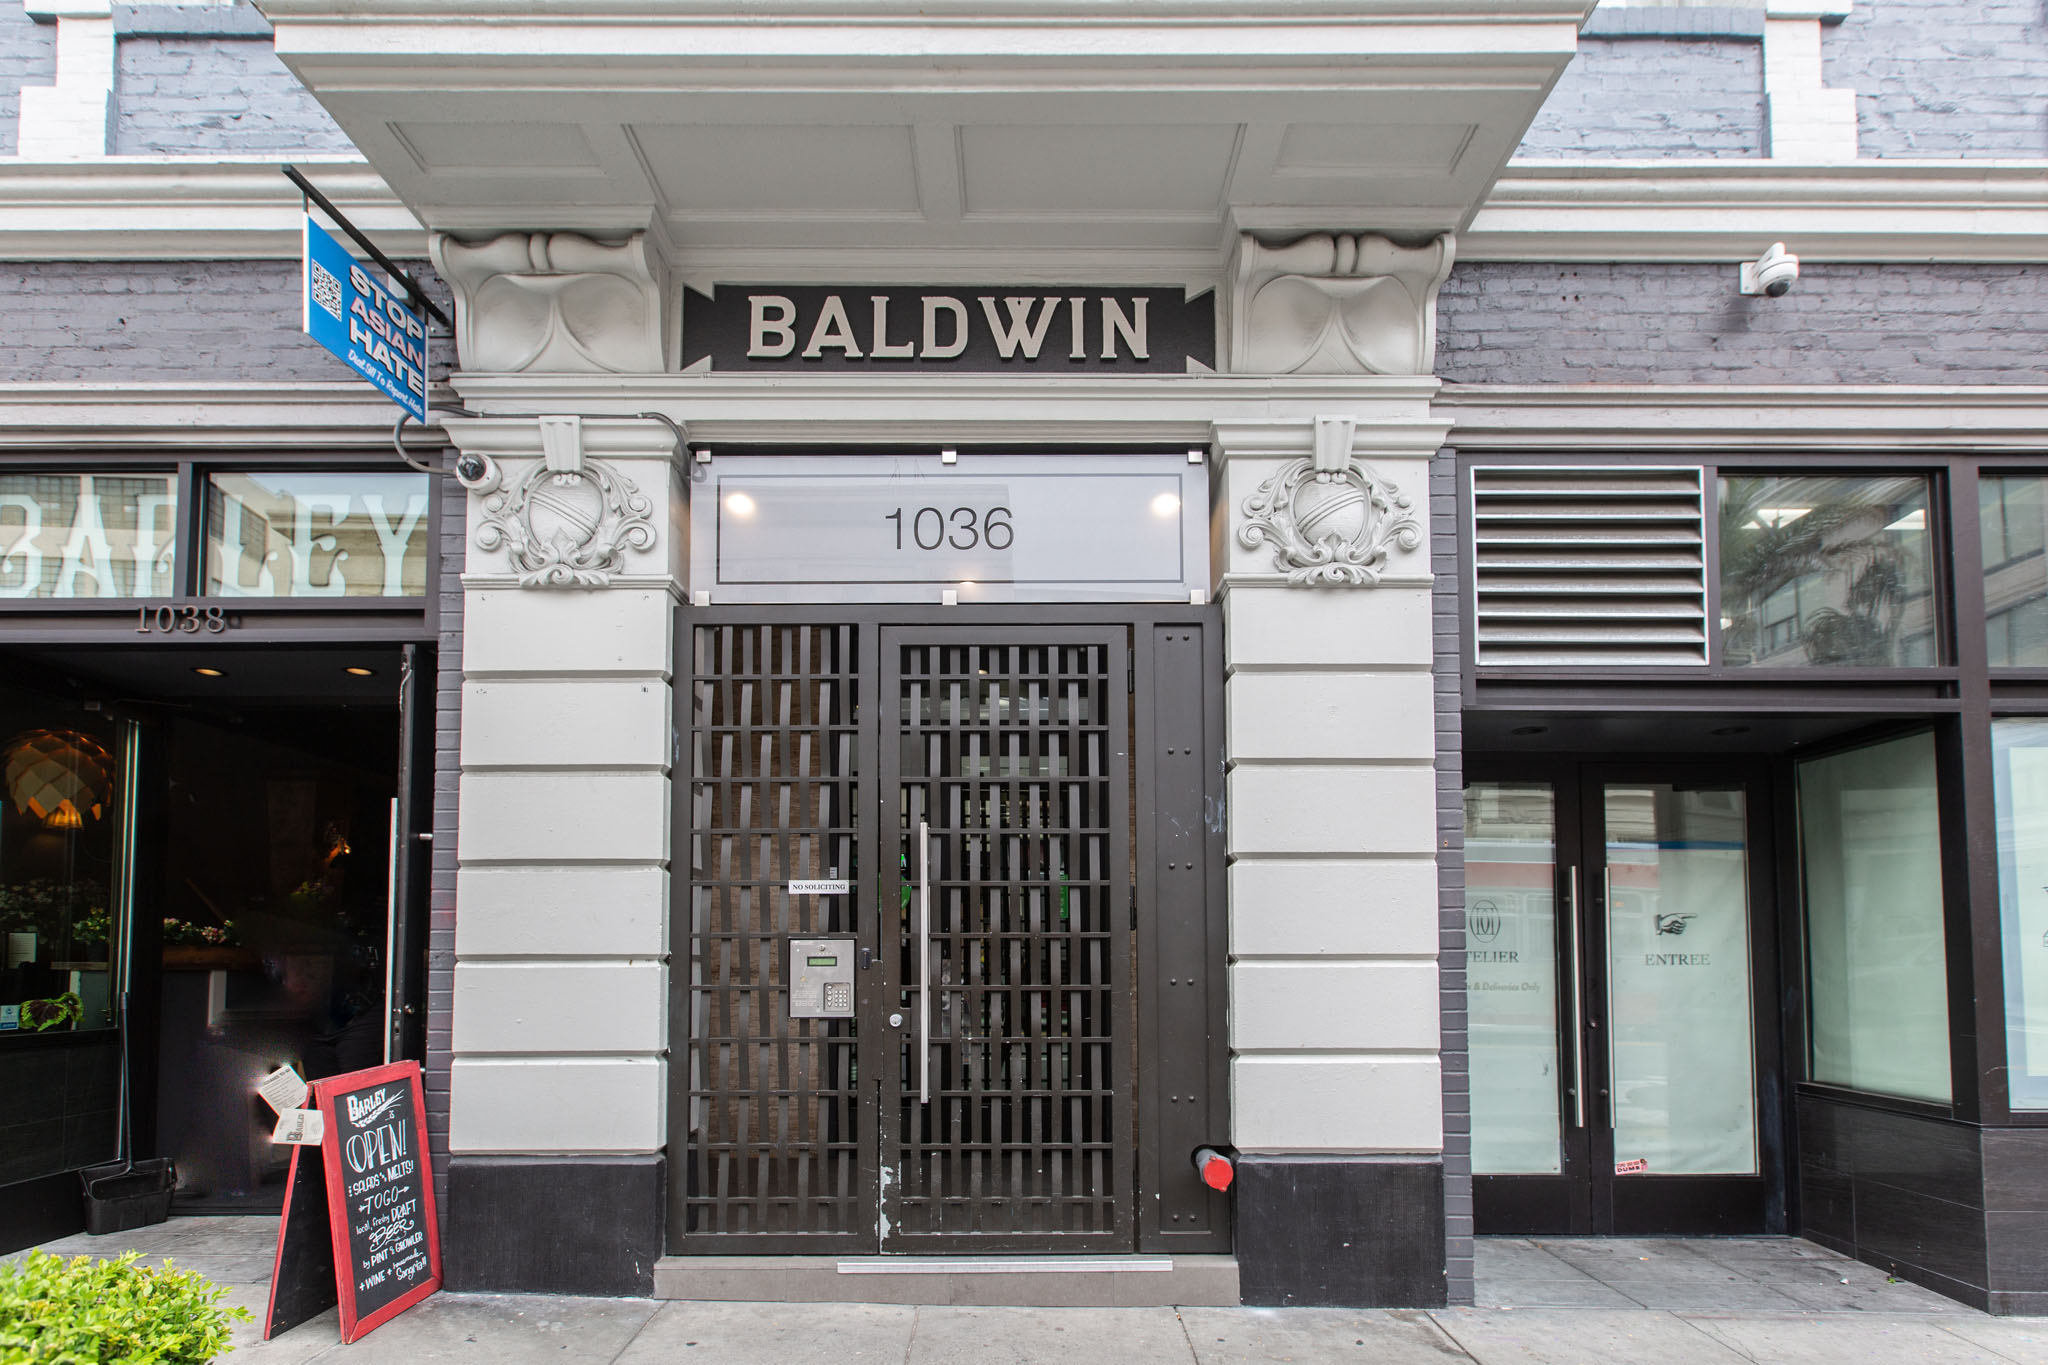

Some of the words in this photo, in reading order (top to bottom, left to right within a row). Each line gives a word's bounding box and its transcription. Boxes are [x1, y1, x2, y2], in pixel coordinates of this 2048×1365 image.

[350, 264, 423, 341] STOP
[350, 296, 423, 372] ASIAN
[747, 295, 1150, 360] BALDWIN
[348, 349, 366, 370] Dial
[376, 370, 386, 386] To
[385, 379, 409, 405] Report
[350, 317, 423, 399] HATE
[885, 507, 1015, 551] 1036
[135, 605, 226, 633] 1038
[1644, 953, 1712, 966] ENTREE
[1521, 982, 1542, 993] Only
[346, 1088, 386, 1122] BARLEY
[346, 1119, 407, 1173] OPEN!
[352, 1173, 381, 1196] SALADS
[386, 1160, 415, 1183] MELTS!
[391, 1198, 417, 1222] DRAFT
[362, 1260, 371, 1270] by
[370, 1248, 388, 1267] PINT
[395, 1231, 424, 1253] GROWLER
[368, 1219, 415, 1253] BEER
